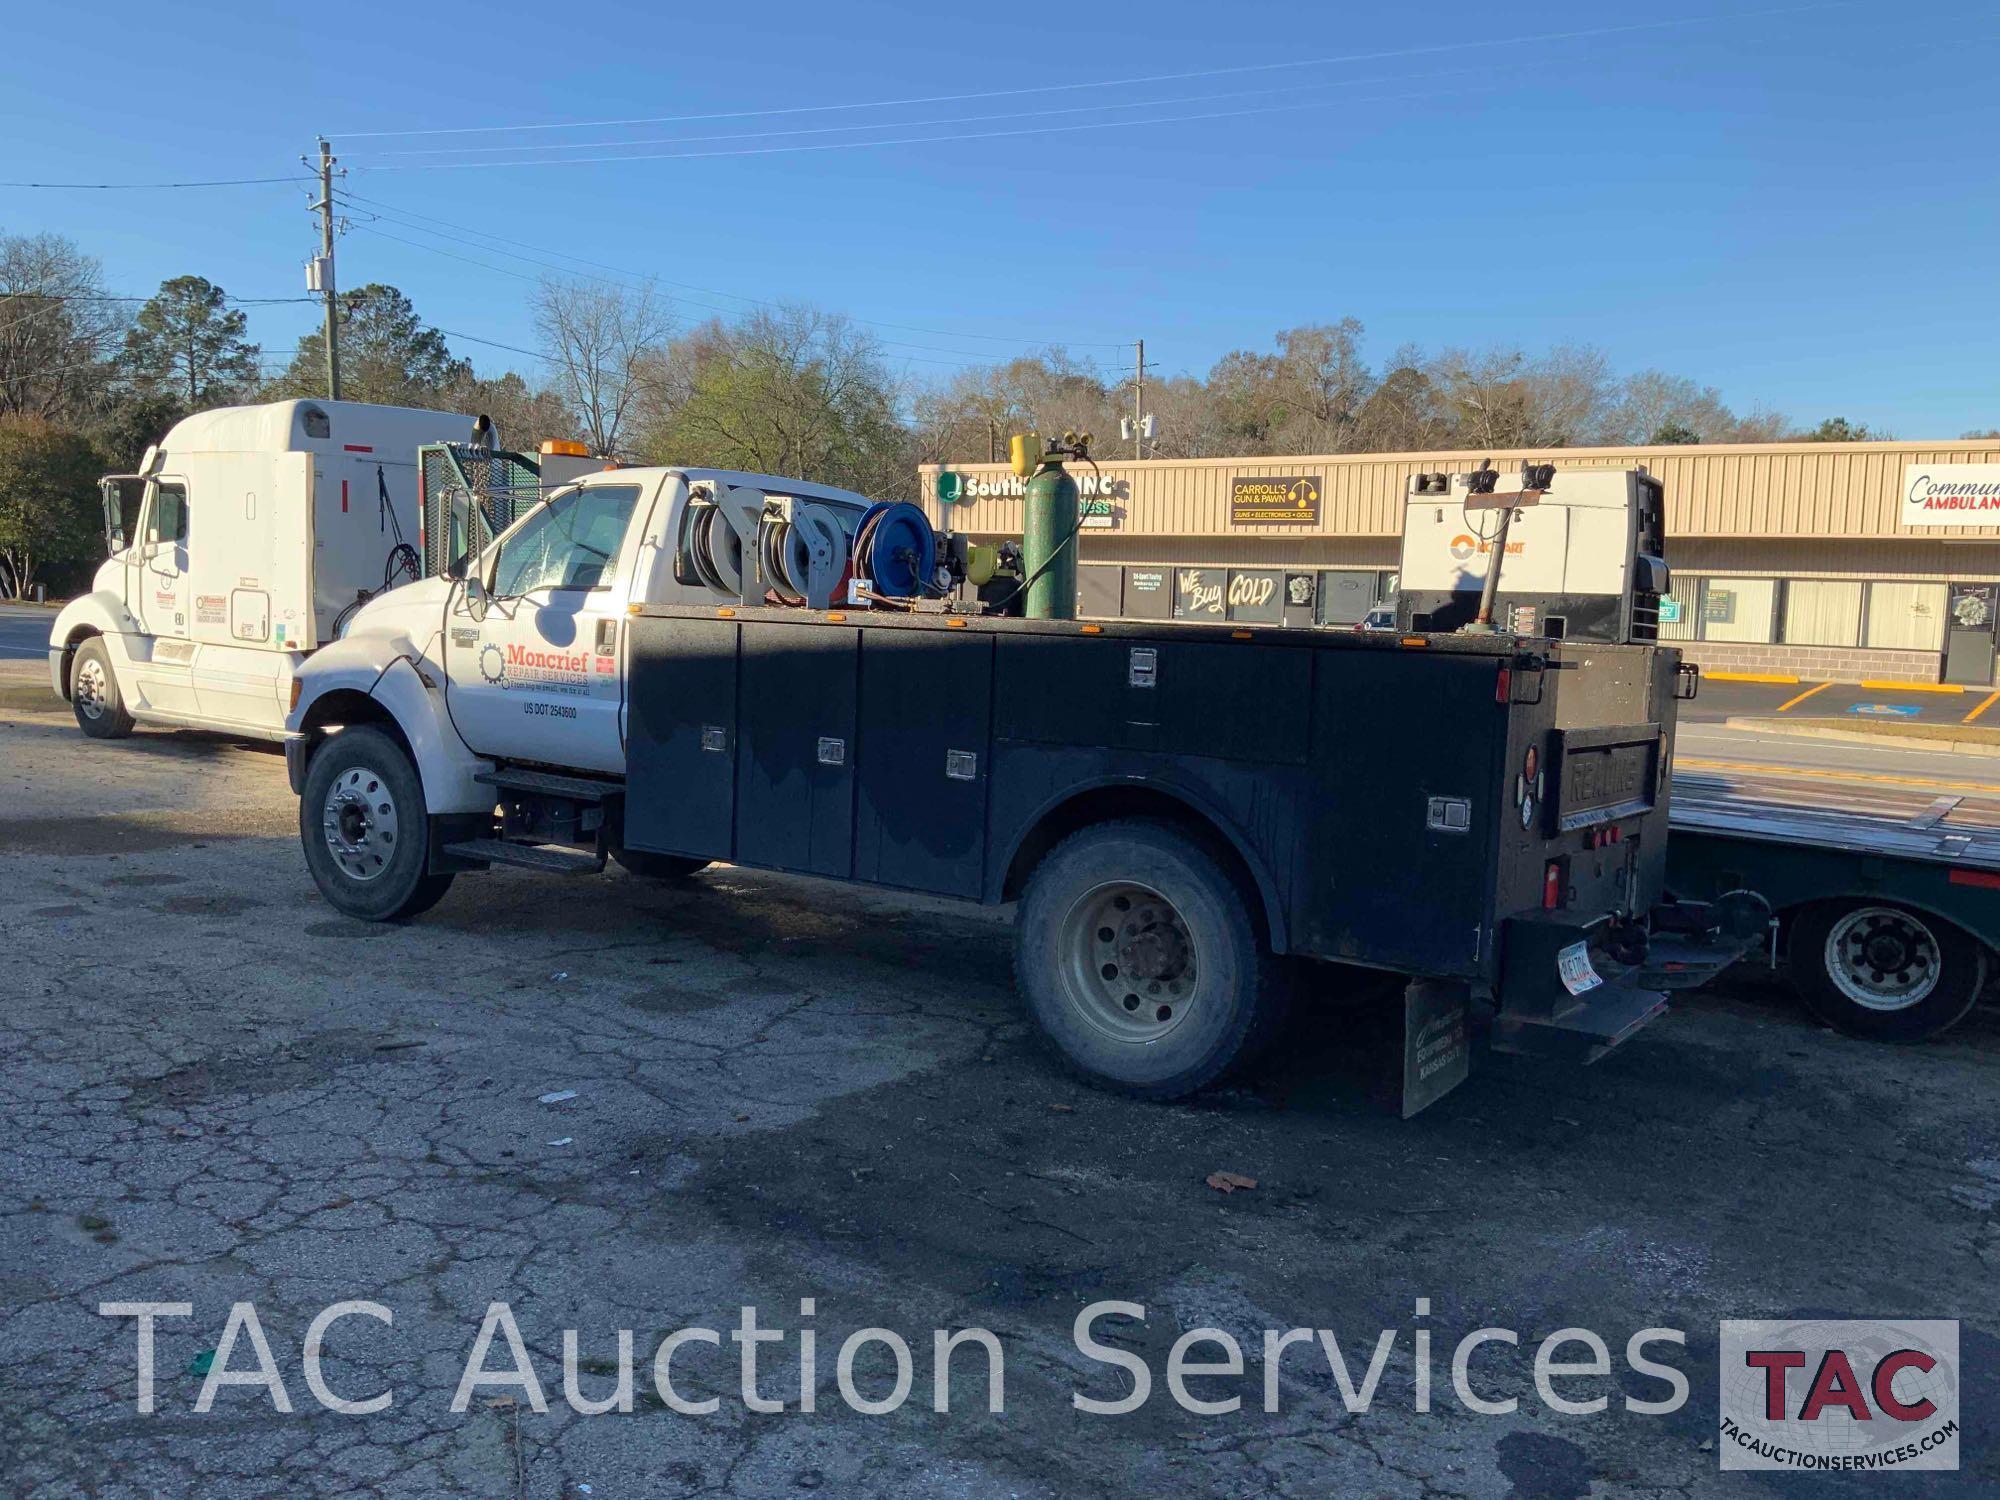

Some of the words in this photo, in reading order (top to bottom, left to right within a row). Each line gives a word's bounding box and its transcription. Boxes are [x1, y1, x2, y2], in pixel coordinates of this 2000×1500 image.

[966, 477, 1026, 496] South
[1074, 476, 1112, 494] INC
[1234, 484, 1287, 494] CARROLL'S
[1233, 495, 1252, 503] GUN
[1253, 495, 1261, 503] &
[1261, 495, 1286, 503] PAWN
[1228, 574, 1273, 606] GOLD
[507, 644, 589, 673] Moncrief
[507, 666, 540, 679] REPAIR
[542, 670, 589, 685] SERVICES
[523, 703, 534, 714] US
[535, 704, 549, 716] DOT
[550, 705, 577, 718] 2543600
